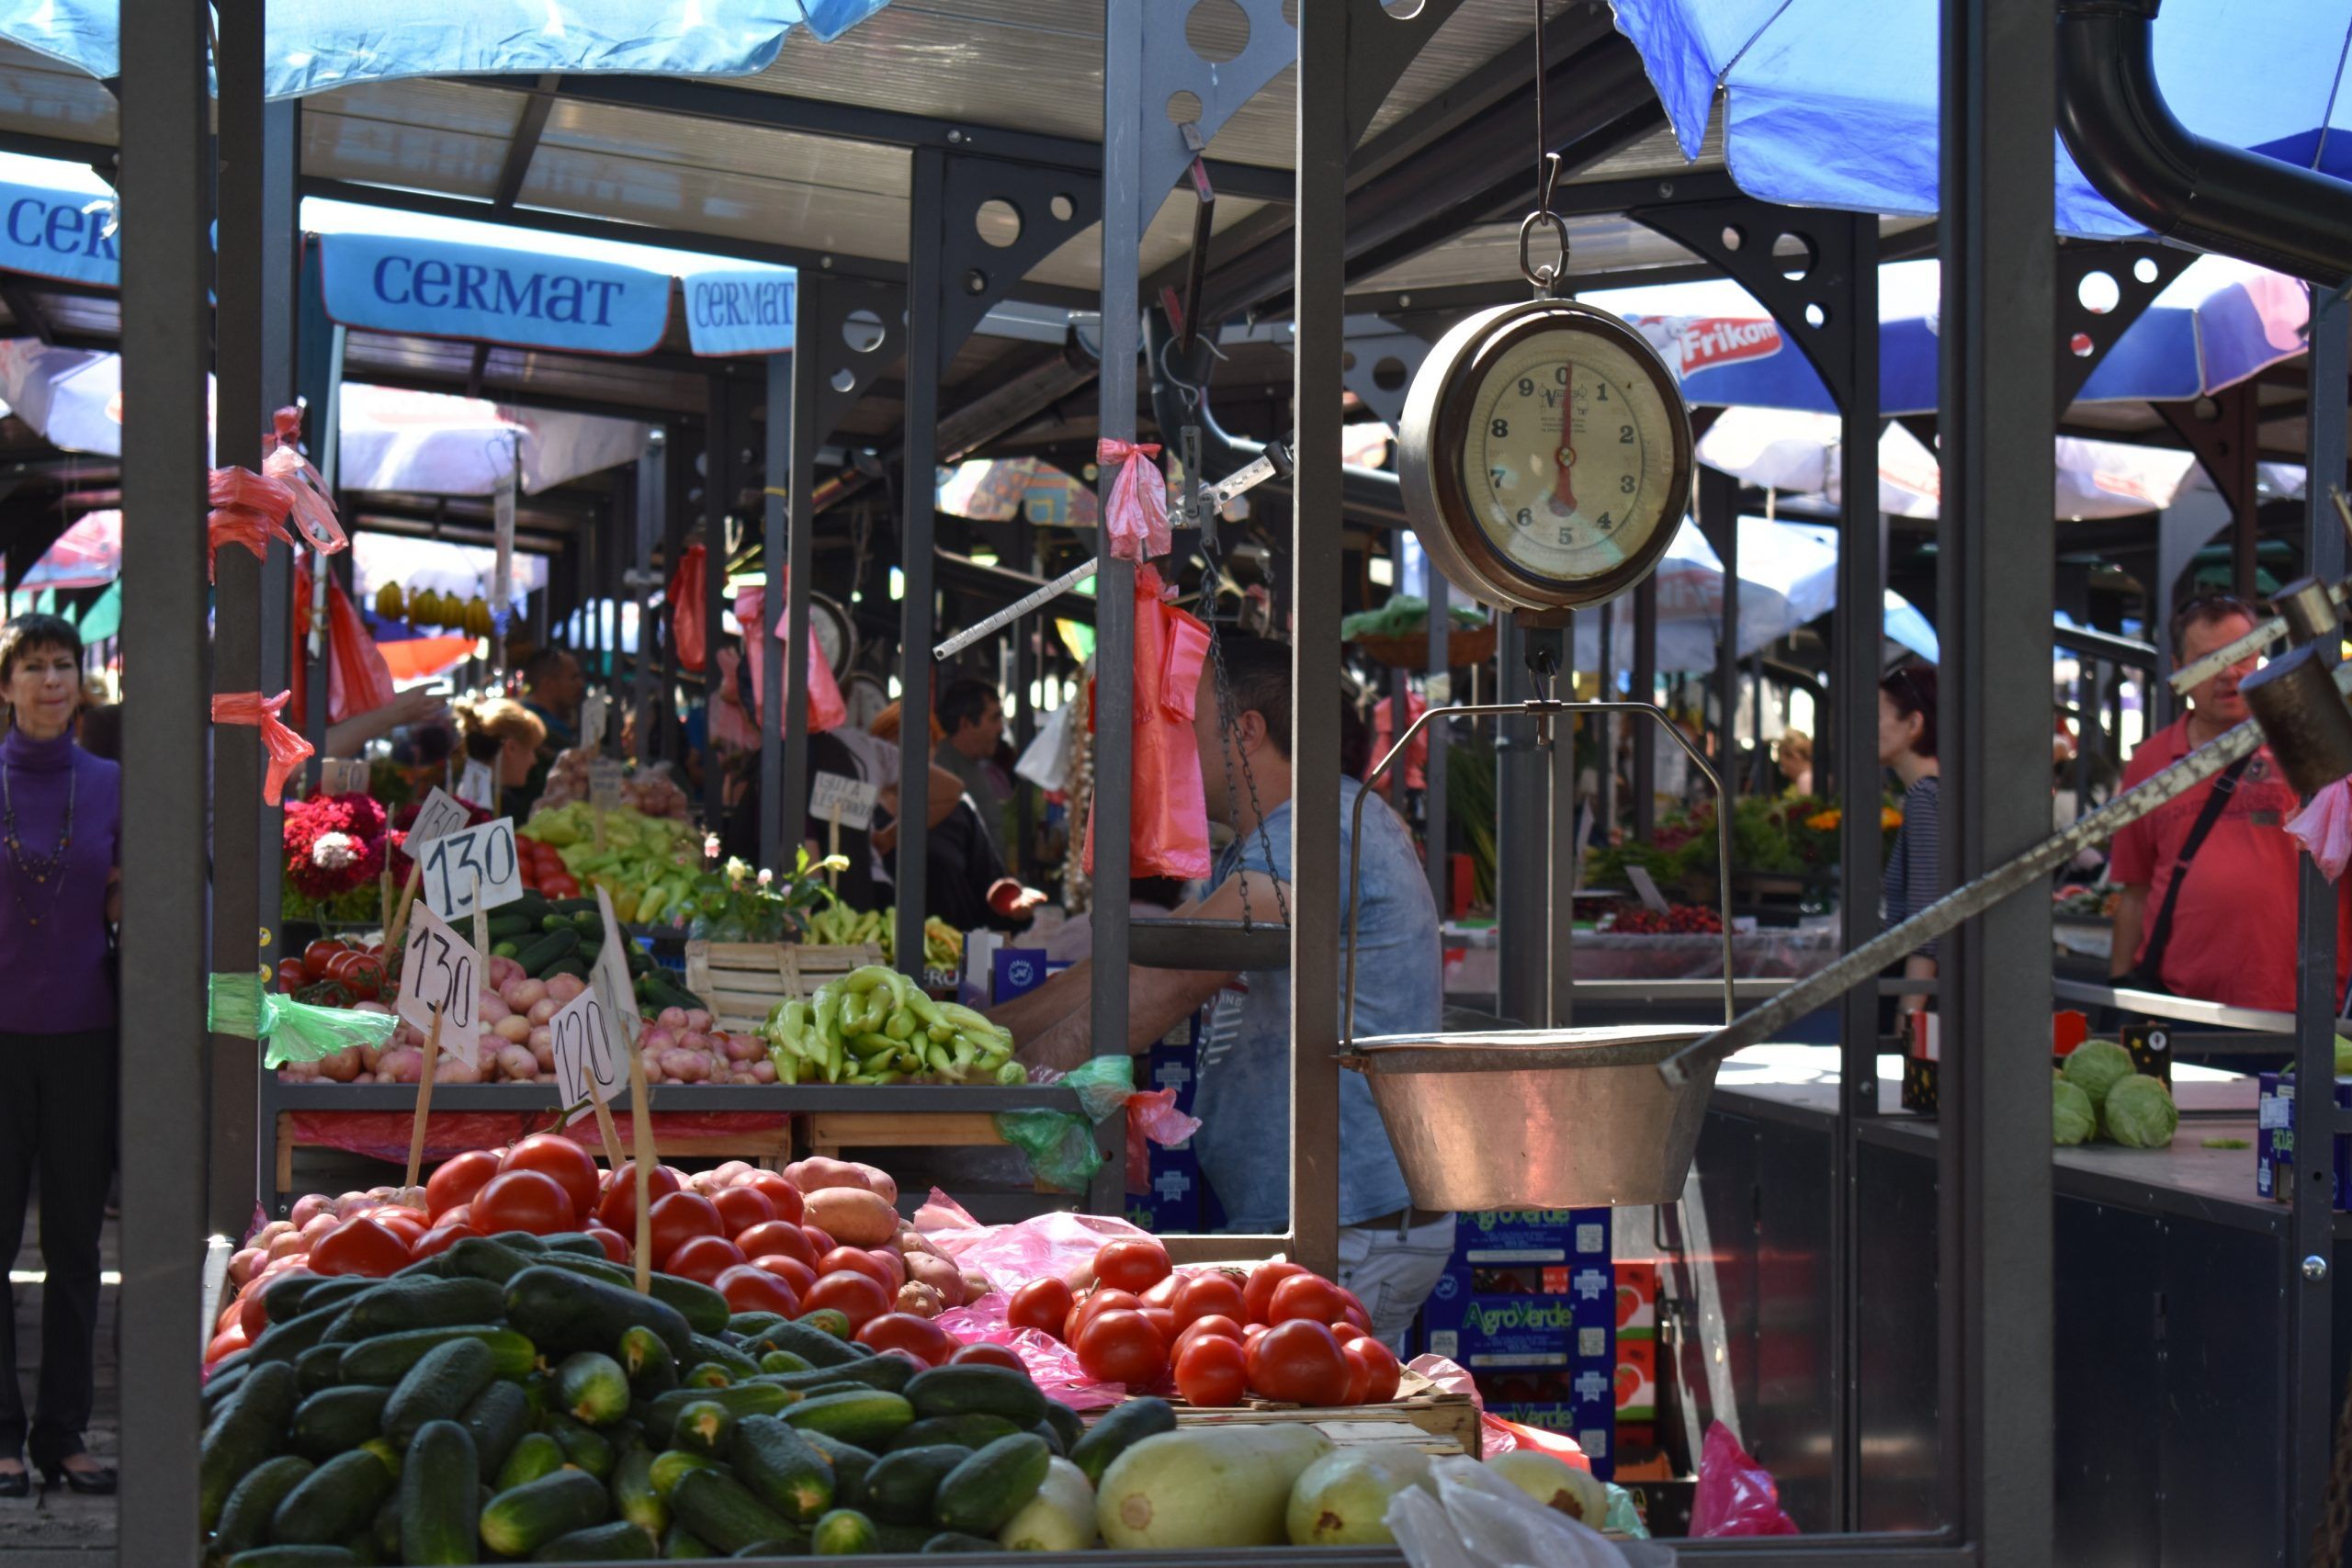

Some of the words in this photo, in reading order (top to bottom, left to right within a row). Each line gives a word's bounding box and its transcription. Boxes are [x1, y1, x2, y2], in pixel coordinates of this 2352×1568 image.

[1682, 321, 1778, 362] Frikom
[1518, 378, 1534, 397] 9
[1597, 382, 1608, 401] 1
[1491, 418, 1509, 438] 8
[1619, 424, 1634, 445] 2
[1490, 468, 1506, 489] 7
[1620, 475, 1635, 493] 3
[1517, 507, 1532, 526] 6
[1597, 512, 1611, 530] 4
[1558, 527, 1573, 545] 5
[425, 824, 514, 916] 130
[412, 926, 472, 1028] 130
[555, 1000, 615, 1105] 120
[1462, 1301, 1573, 1336] AgroVerde
